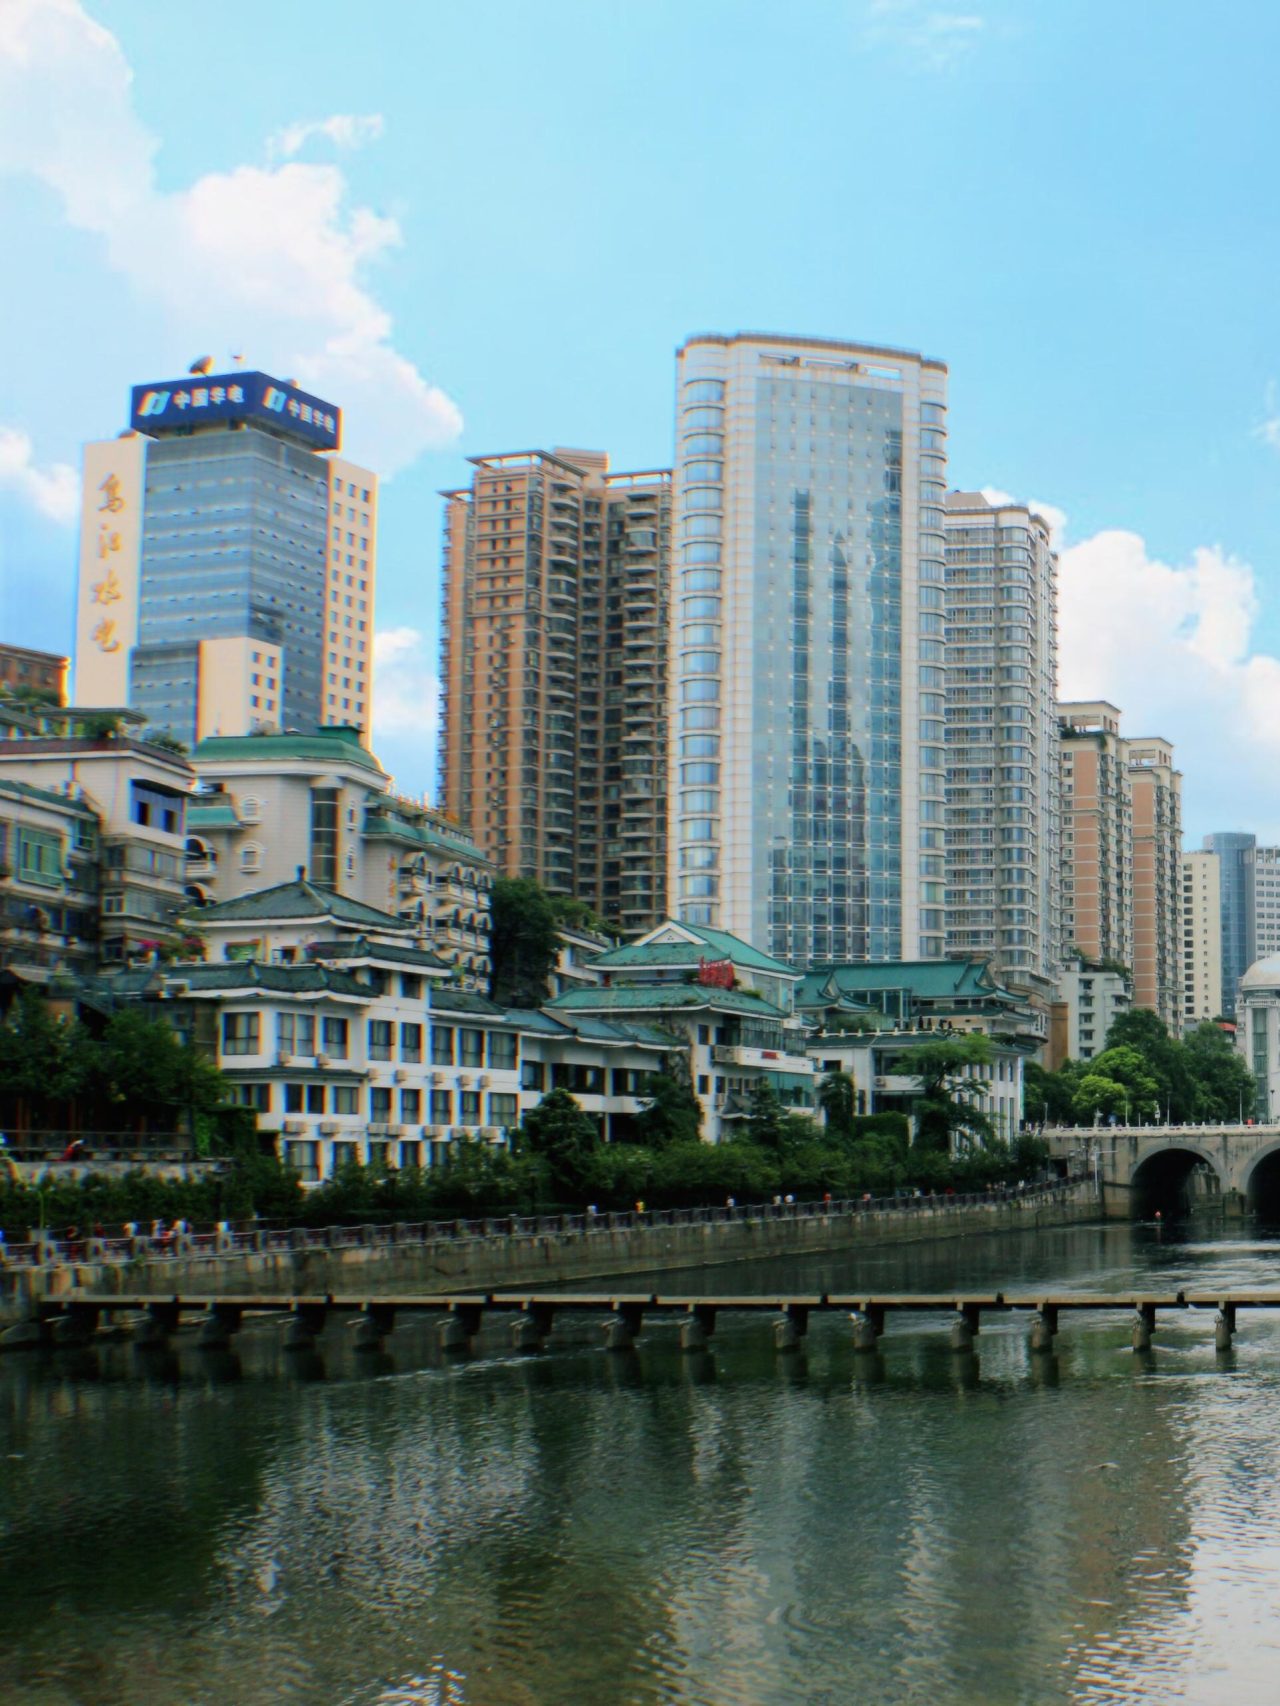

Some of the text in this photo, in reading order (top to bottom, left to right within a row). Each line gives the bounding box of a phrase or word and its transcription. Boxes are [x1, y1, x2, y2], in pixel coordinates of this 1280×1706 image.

[173, 384, 244, 410] 中国华电
[287, 398, 335, 434] 中国华电
[91, 473, 126, 652] 乌江水电
